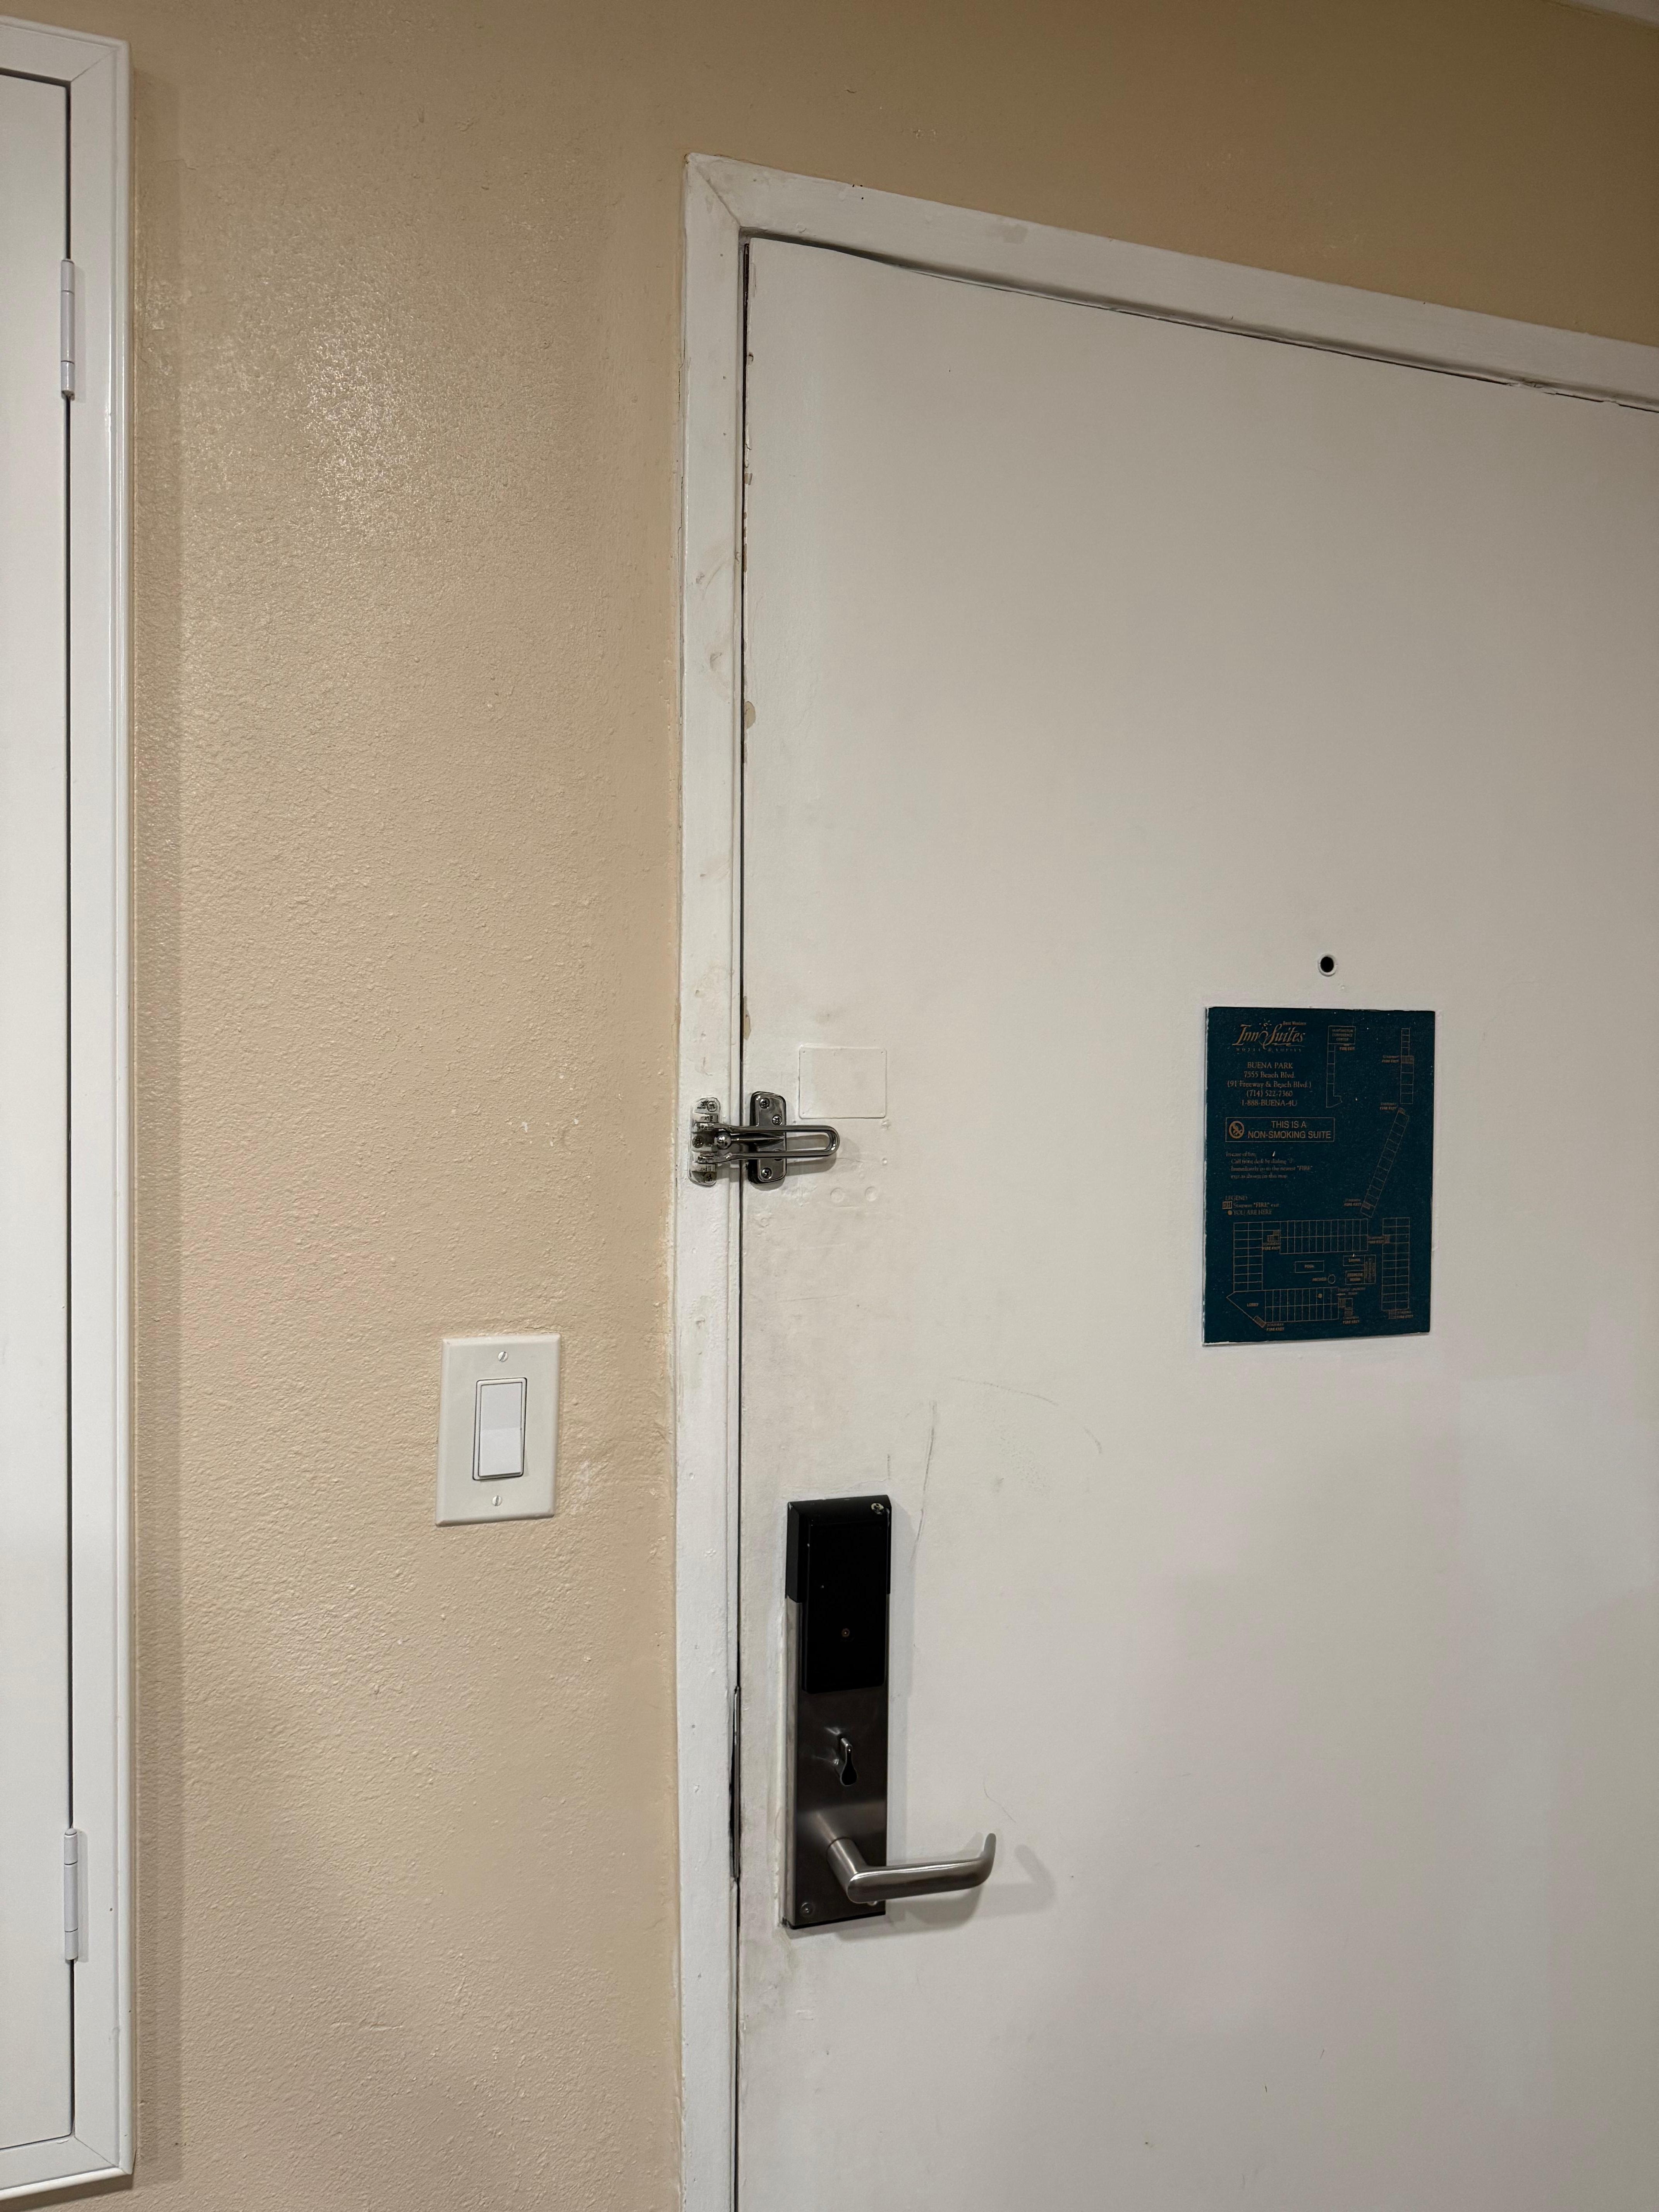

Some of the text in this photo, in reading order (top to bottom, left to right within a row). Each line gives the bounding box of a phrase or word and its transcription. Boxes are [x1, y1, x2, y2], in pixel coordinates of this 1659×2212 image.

[1232, 1024, 1306, 1049] Inn Suites
[1239, 1080, 1264, 1089] Freeway
